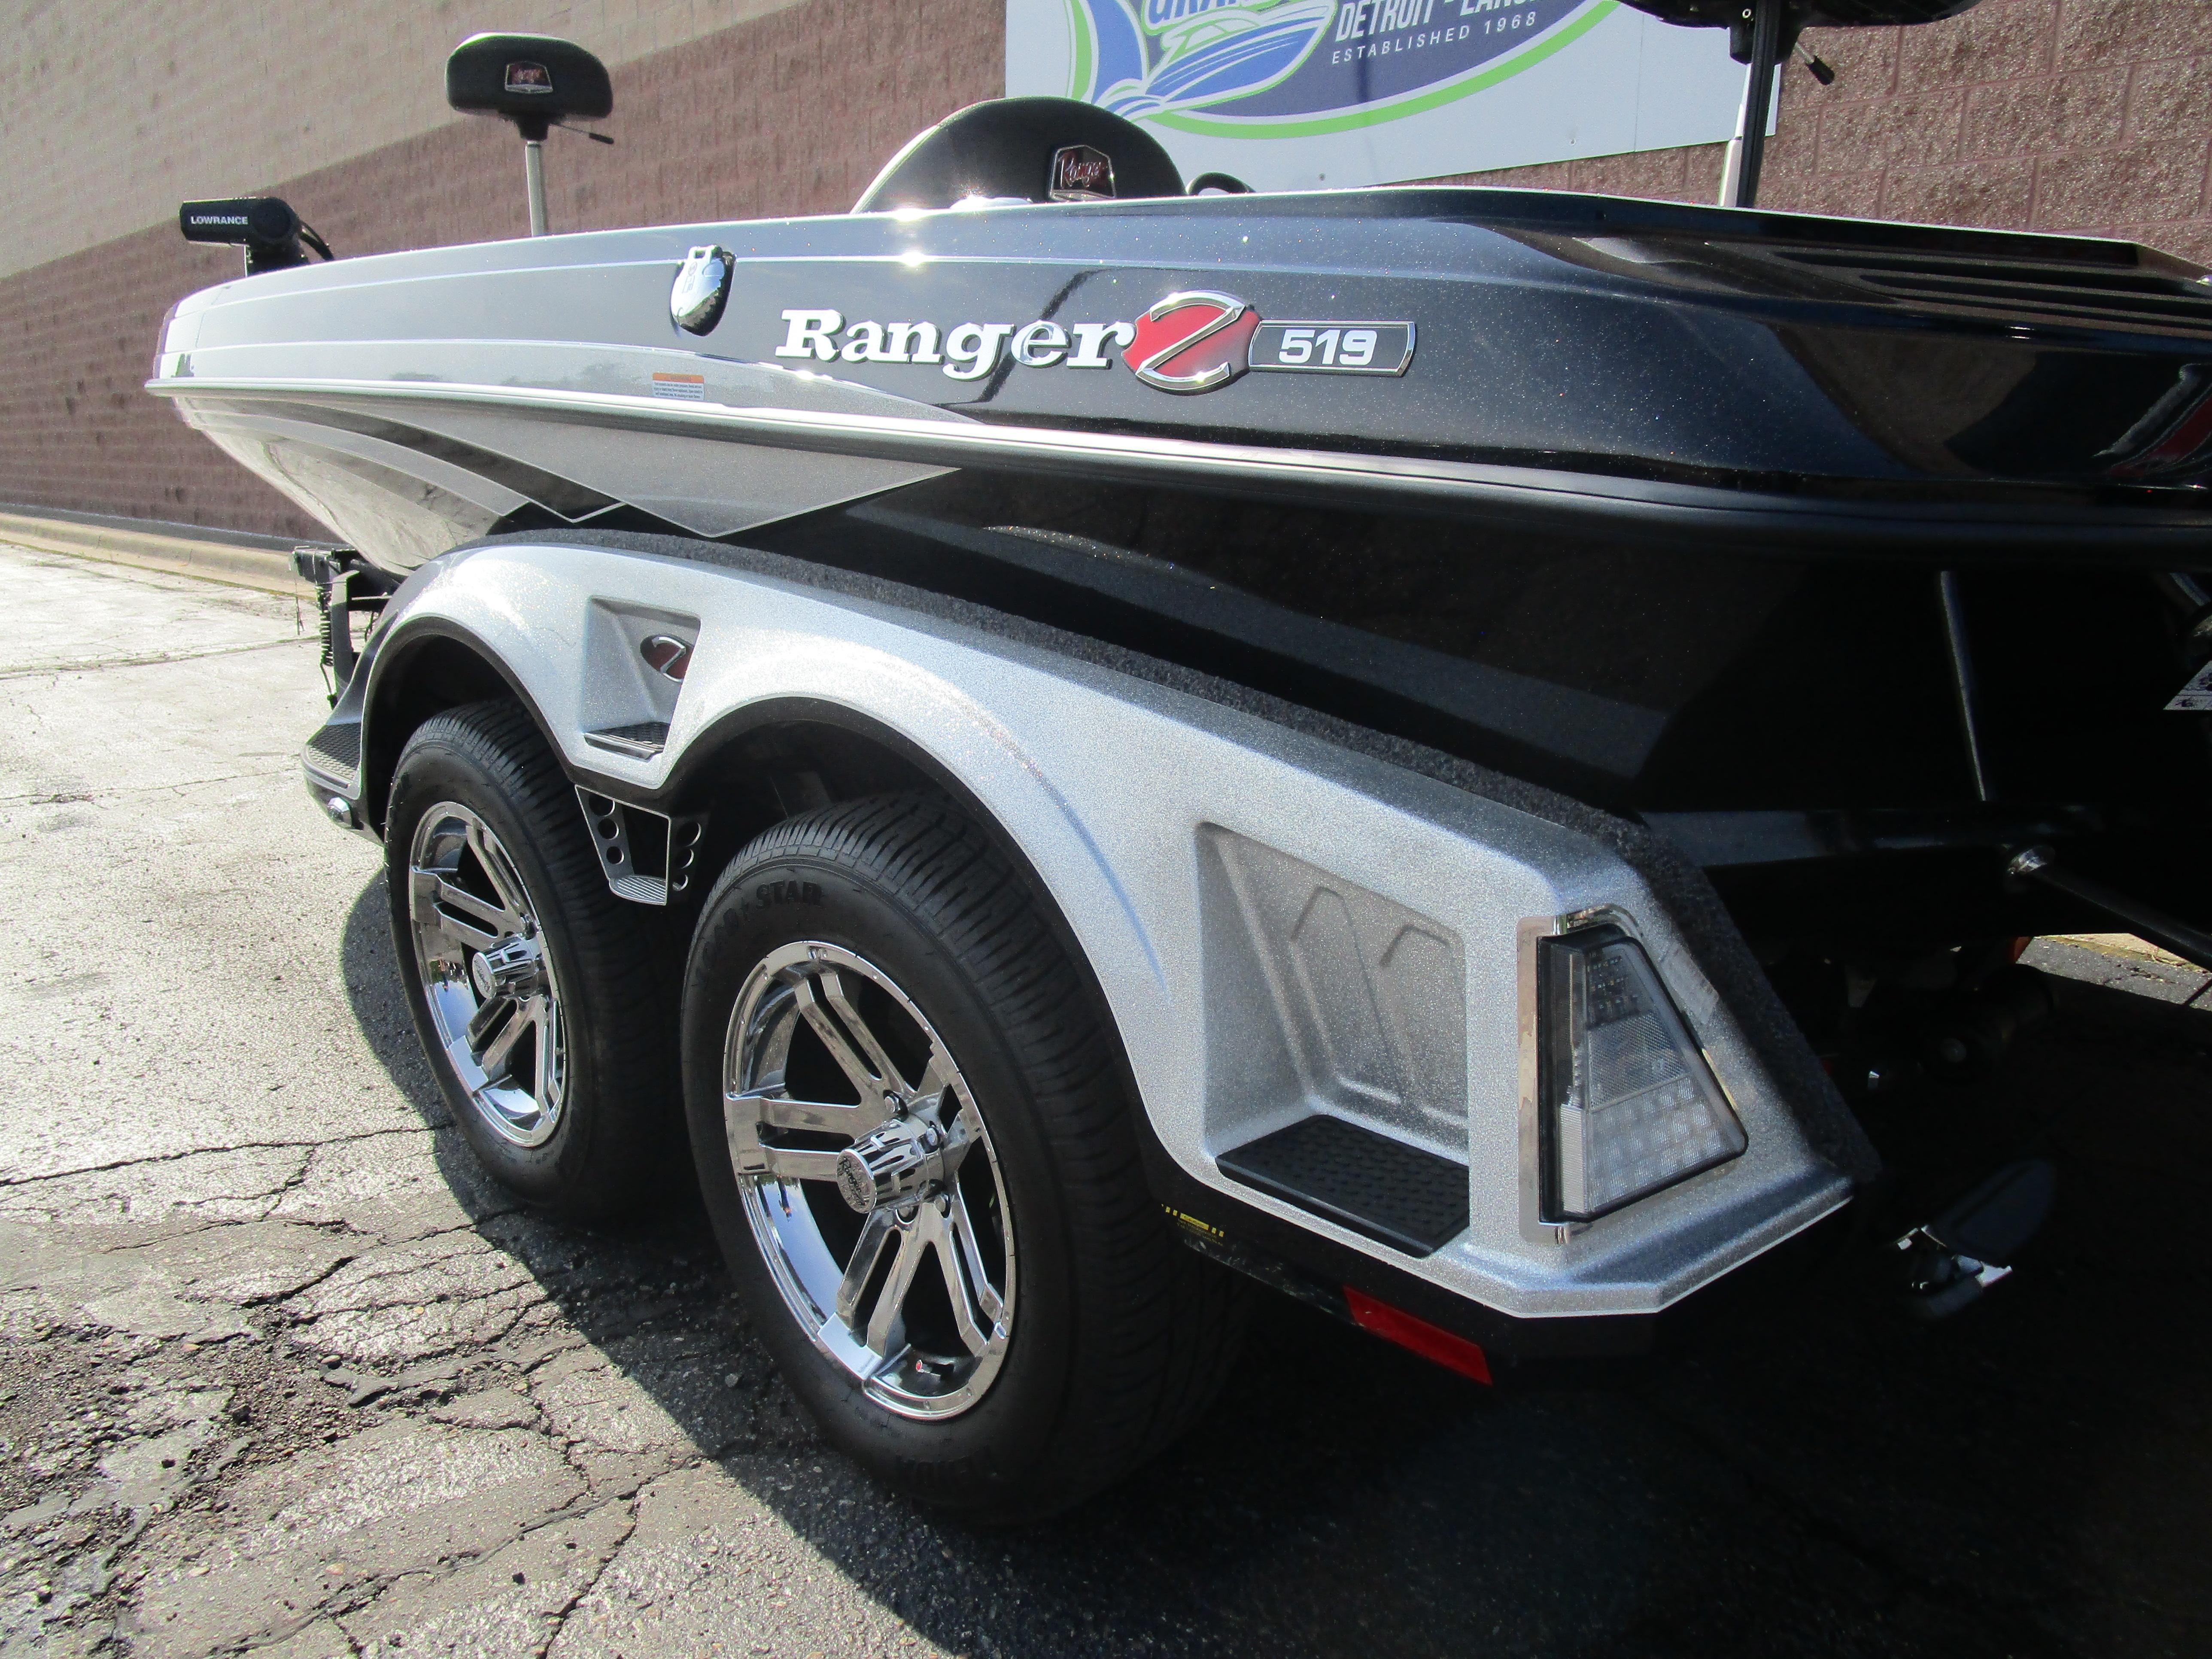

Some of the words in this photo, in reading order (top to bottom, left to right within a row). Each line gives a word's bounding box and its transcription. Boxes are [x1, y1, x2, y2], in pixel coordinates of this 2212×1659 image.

[1331, 24, 1470, 64] ESTABLISHED
[1484, 11, 1537, 34] 1968
[190, 216, 248, 225] LOWRANCE
[775, 309, 1136, 381] Ranger
[1135, 289, 1246, 390] Z
[1278, 329, 1378, 365] 519
